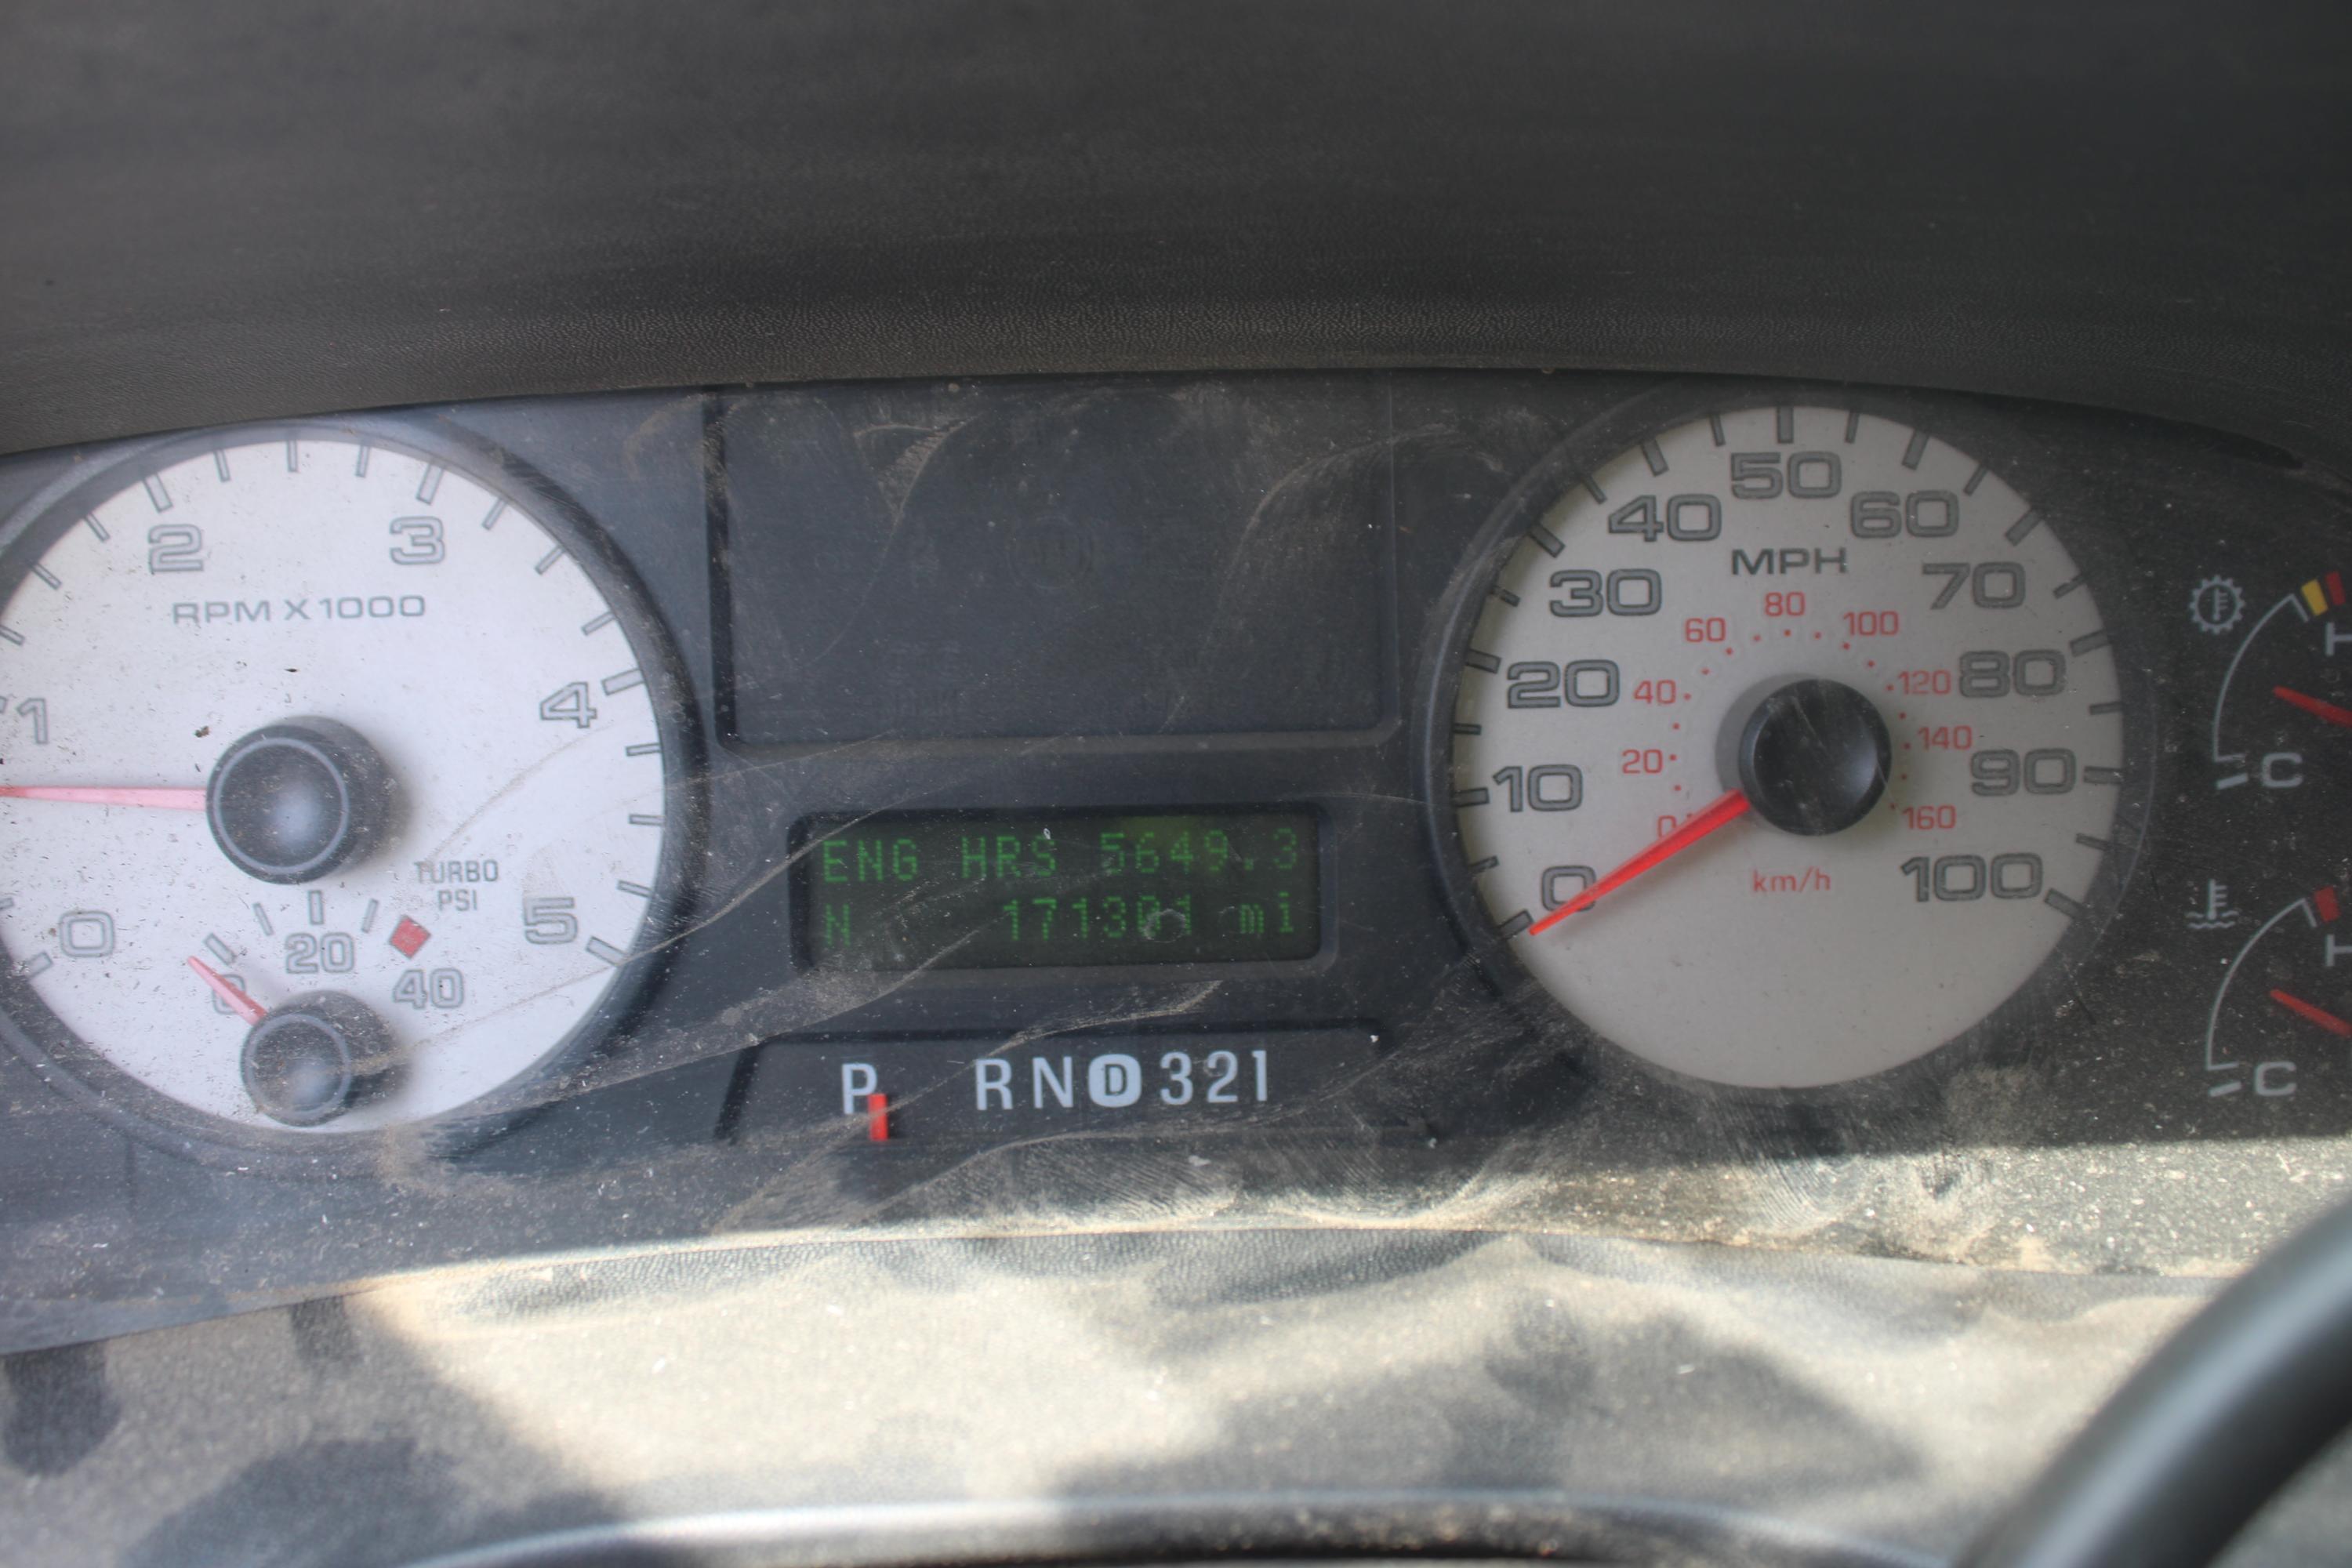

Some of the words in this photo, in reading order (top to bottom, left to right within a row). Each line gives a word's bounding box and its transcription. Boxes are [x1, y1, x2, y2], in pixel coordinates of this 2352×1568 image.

[1730, 451, 1842, 499] 50
[1608, 493, 1723, 543] 40
[1850, 490, 1960, 539] 60
[147, 524, 205, 575] 2
[389, 516, 446, 566] 3
[1731, 547, 1848, 575] MPH
[1549, 568, 1663, 618] 30
[1764, 590, 1806, 618] 80
[1922, 561, 2027, 611] 70
[172, 600, 271, 625] RPM
[1684, 616, 1726, 643] 60
[1842, 610, 1900, 637] 100
[1507, 659, 1621, 710] 20
[1633, 679, 1677, 705] 40
[1897, 670, 1952, 695] 120
[1958, 649, 2067, 699] 80
[16, 698, 49, 745] 1
[540, 681, 598, 729] 4
[1917, 724, 1973, 751] 140
[1621, 749, 1664, 775] 20
[1970, 748, 2078, 797] 90
[2261, 752, 2303, 788] C
[1492, 764, 1583, 814] 10
[1901, 804, 1957, 830] 160
[413, 859, 499, 884] TURBO
[823, 839, 918, 883] ENG
[961, 835, 1056, 879] HRS
[1100, 828, 1298, 874] 5649.3
[1900, 853, 2045, 903] 100
[437, 889, 479, 912] PSI
[1541, 865, 1596, 913] 0
[1752, 866, 1832, 894] km/h
[59, 909, 116, 958] 0
[522, 897, 579, 945] 5
[825, 903, 851, 947] N
[1240, 891, 1294, 935] mi
[285, 932, 356, 975] 20
[394, 967, 465, 1010] 40
[841, 1062, 879, 1114] P
[2254, 1061, 2297, 1097] C
